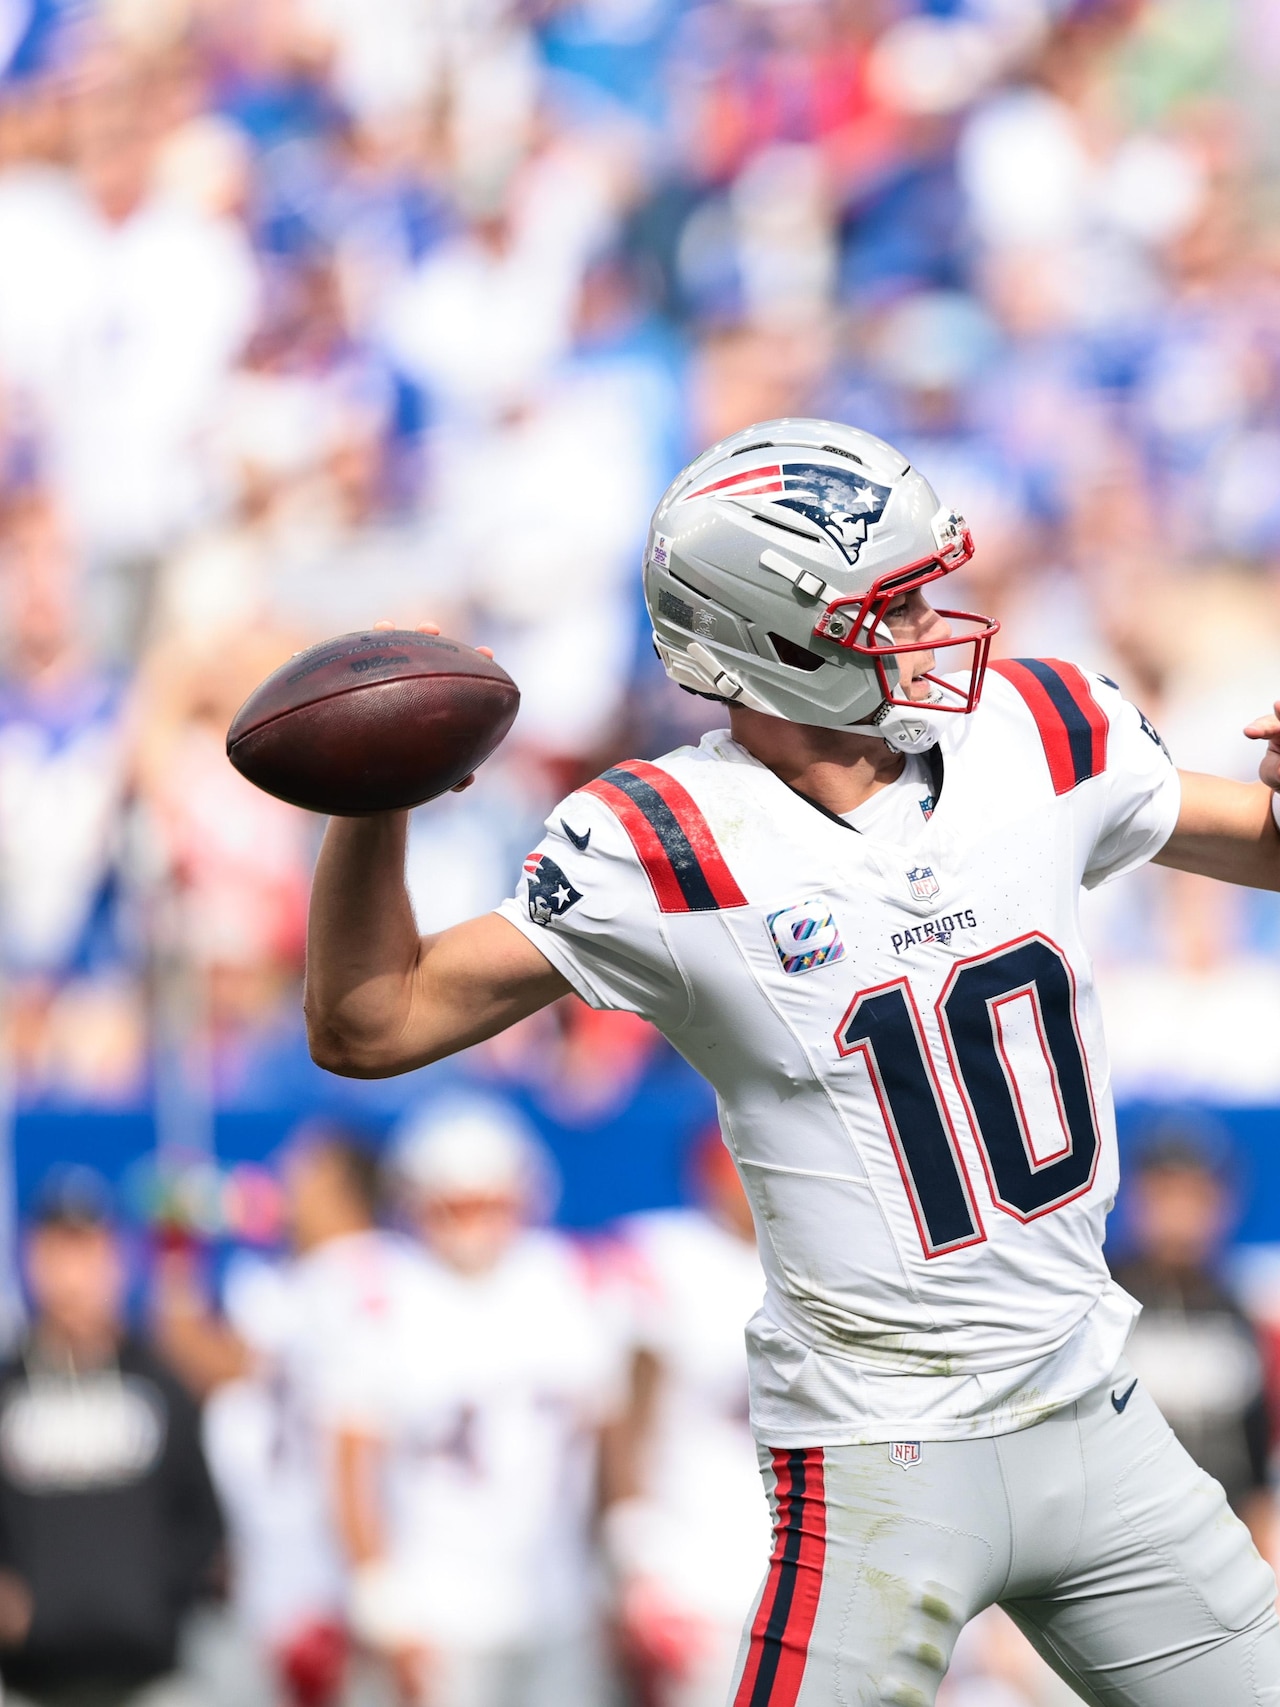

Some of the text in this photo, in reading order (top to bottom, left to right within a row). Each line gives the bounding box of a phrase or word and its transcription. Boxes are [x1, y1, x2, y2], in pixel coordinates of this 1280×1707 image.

[913, 878, 938, 895] NFL
[772, 903, 836, 955] C
[890, 909, 977, 955] PATRIOTS
[832, 930, 1101, 1260] 10
[895, 1444, 918, 1461] NFL
